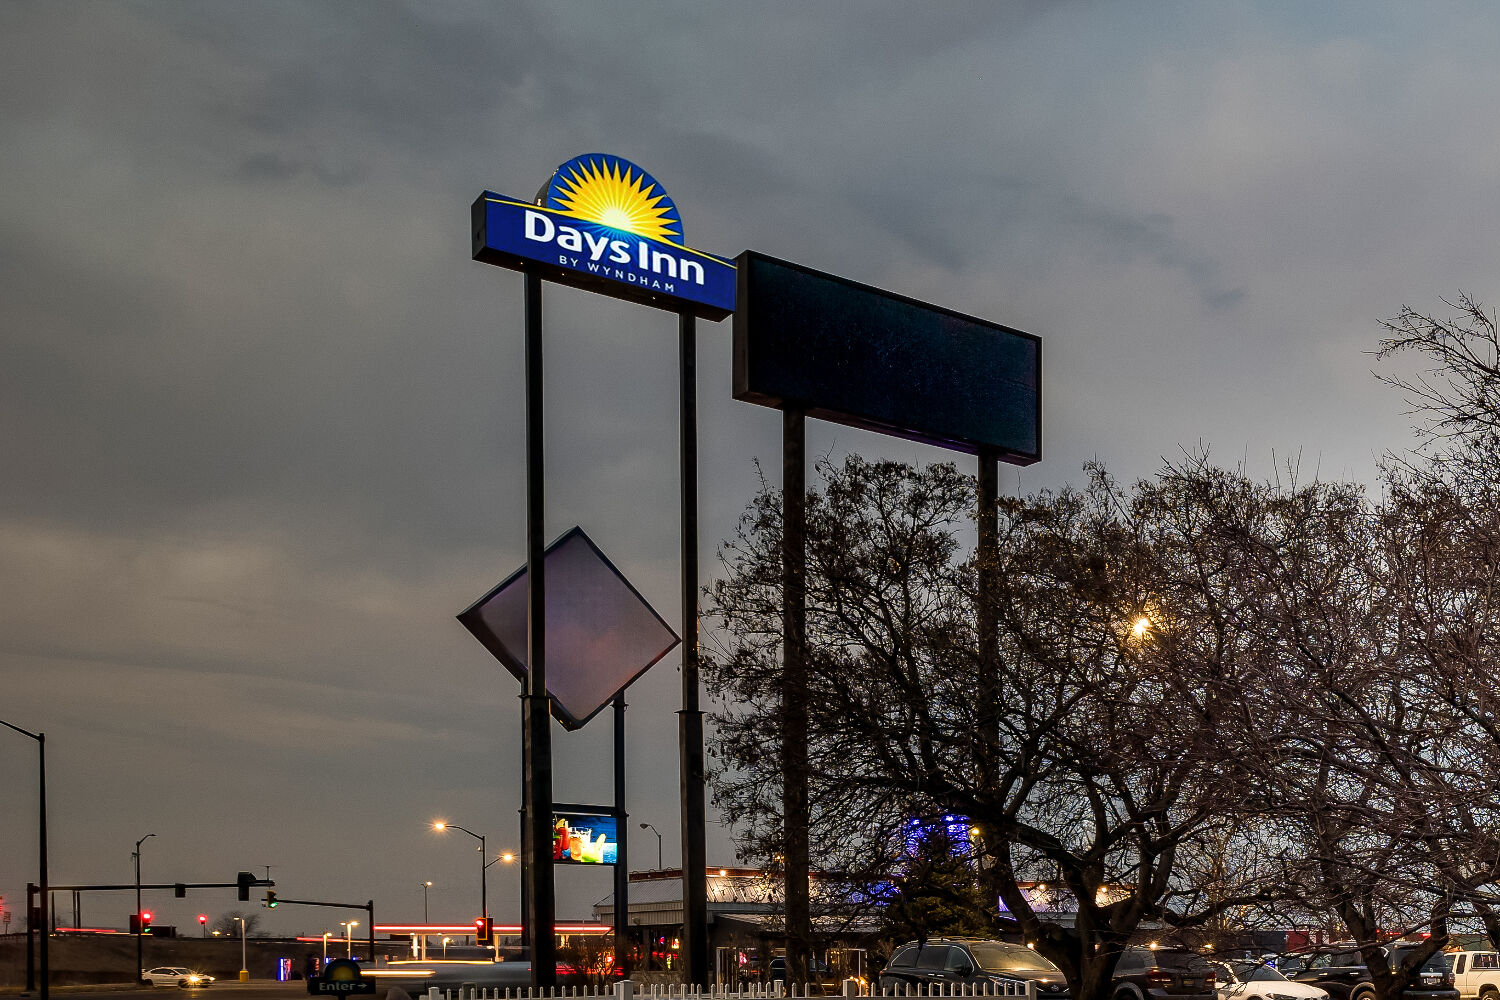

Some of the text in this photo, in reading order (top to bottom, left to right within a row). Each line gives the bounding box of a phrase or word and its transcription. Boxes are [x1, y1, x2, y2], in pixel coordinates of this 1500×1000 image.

[525, 210, 705, 285] Days Inn
[558, 255, 675, 293] BY WYNDHAM
[319, 981, 356, 991] Enter
